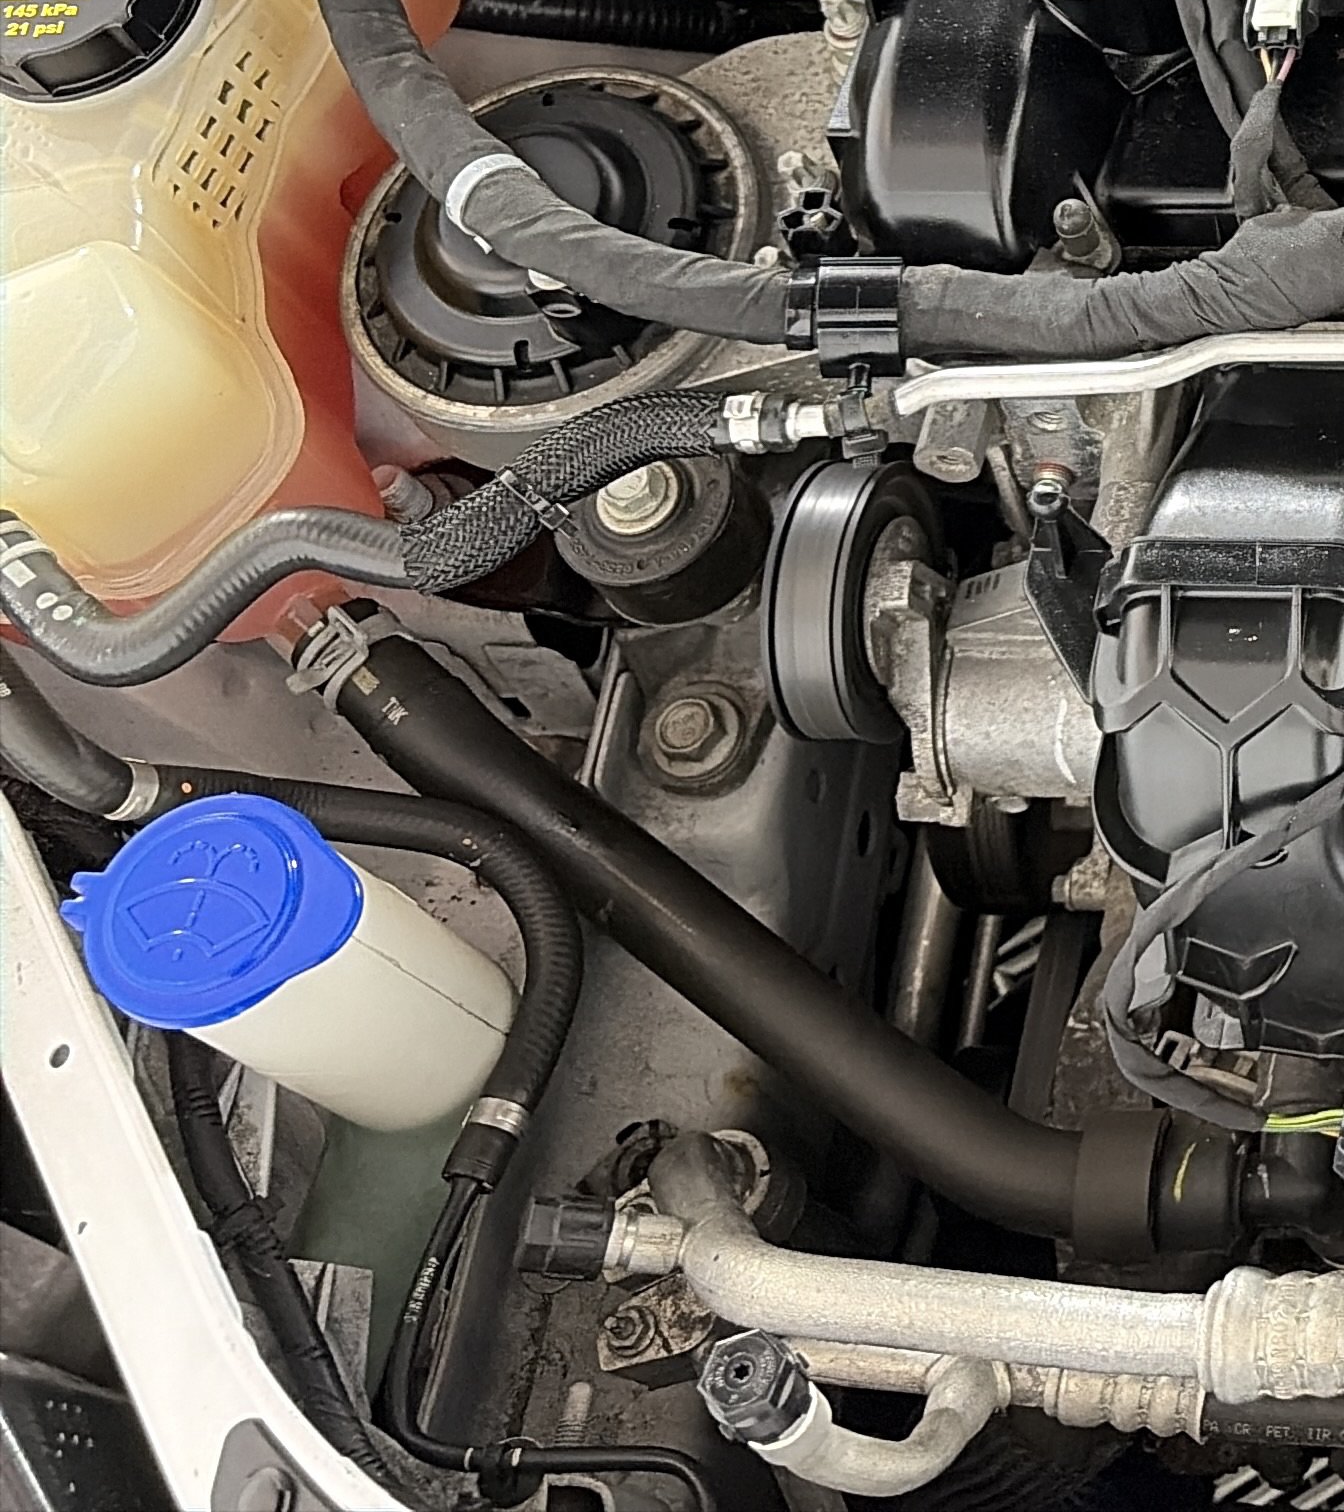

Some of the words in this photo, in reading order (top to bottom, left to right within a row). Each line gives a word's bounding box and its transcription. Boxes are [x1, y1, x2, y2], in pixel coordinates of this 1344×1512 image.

[3, 4, 38, 19] 145
[41, 3, 78, 18] kPa
[4, 23, 33, 37] 21
[36, 20, 65, 38] psi
